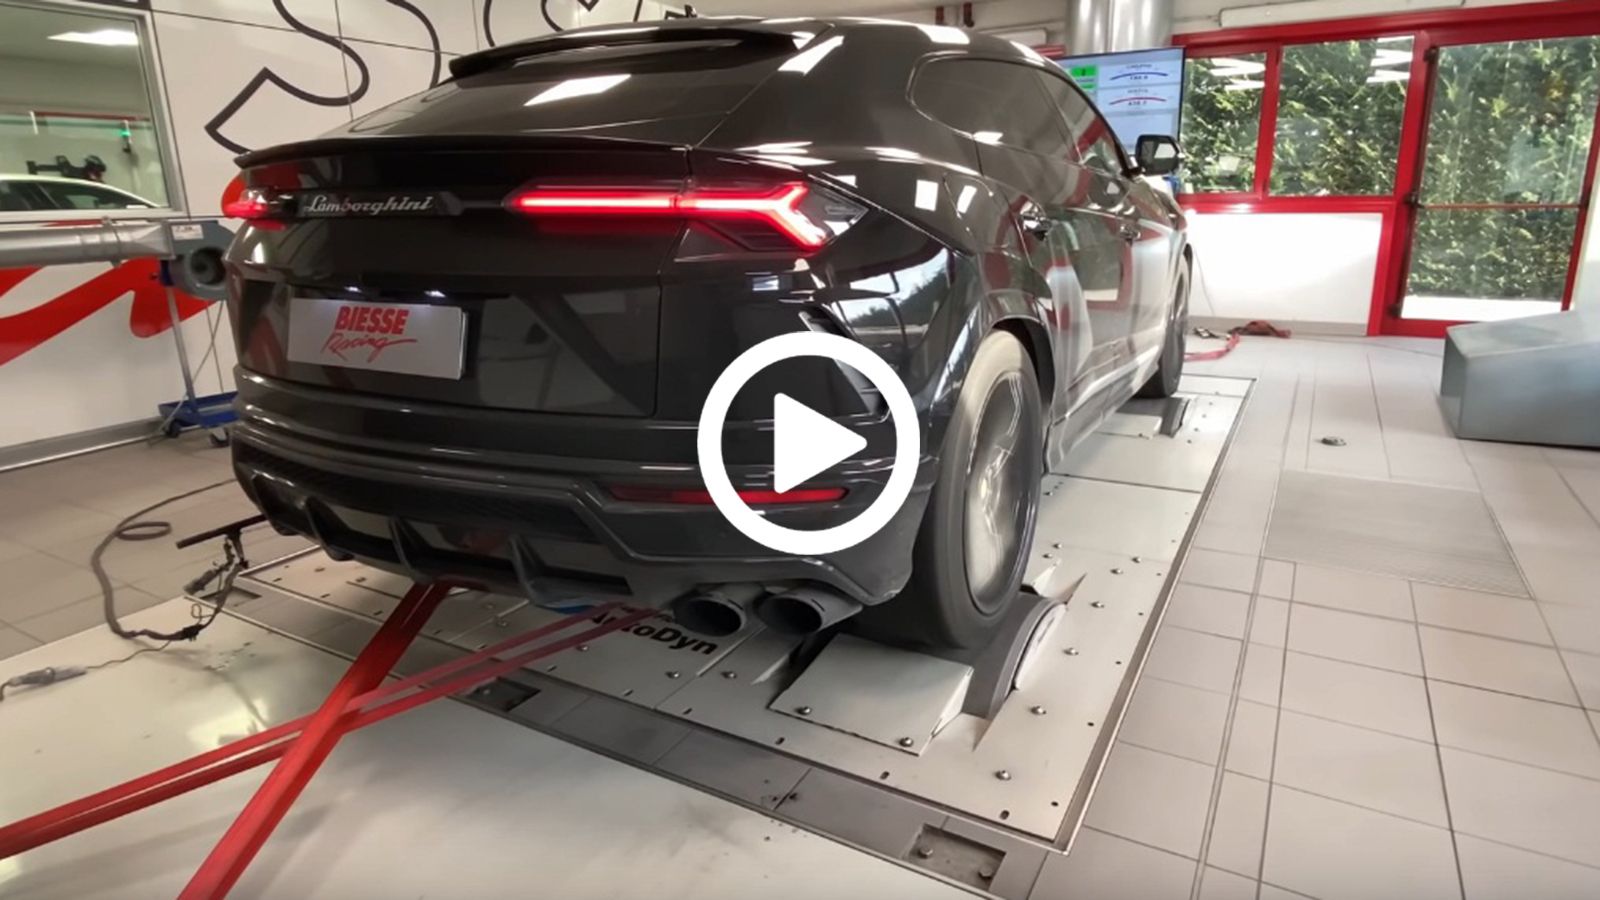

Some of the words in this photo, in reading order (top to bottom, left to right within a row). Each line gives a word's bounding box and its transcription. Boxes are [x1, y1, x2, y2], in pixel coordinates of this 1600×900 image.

[305, 194, 434, 216] Lamborghini
[334, 305, 410, 335] BIESSE
[320, 332, 418, 363] Racing
